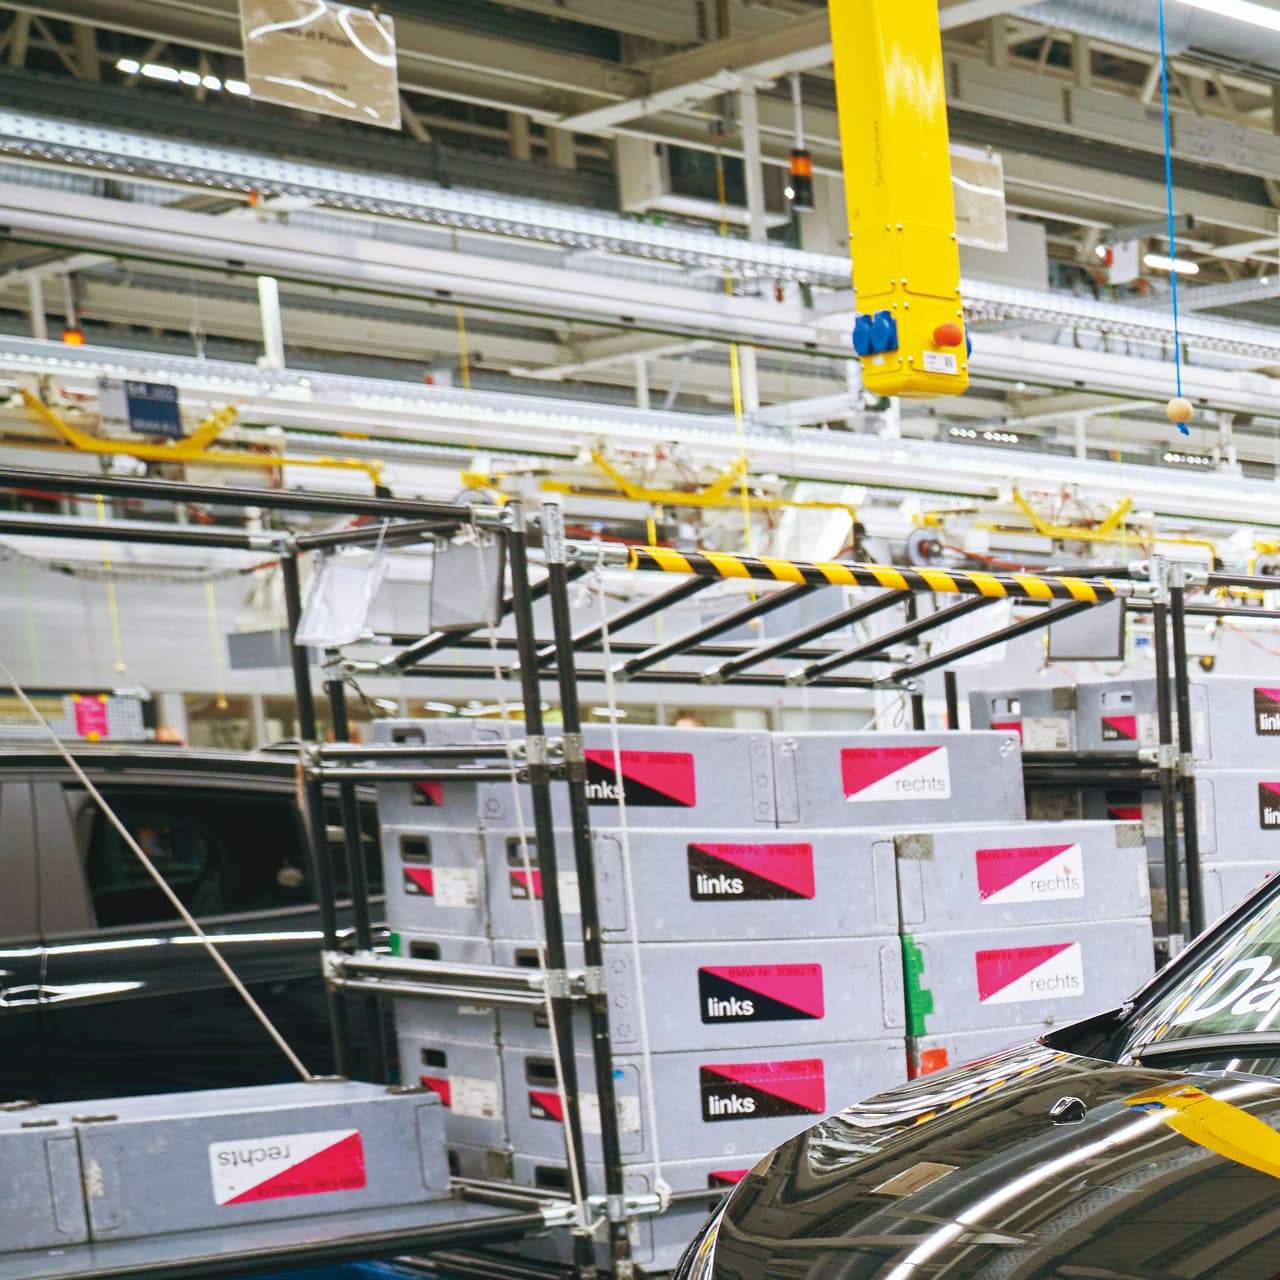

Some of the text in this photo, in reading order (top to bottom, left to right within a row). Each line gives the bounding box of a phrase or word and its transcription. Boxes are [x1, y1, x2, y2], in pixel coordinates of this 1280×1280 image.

[584, 780, 626, 800] inks
[896, 775, 945, 793] rechts
[696, 874, 744, 895] links
[1031, 874, 1080, 894] rechts
[1031, 973, 1080, 993] rechts
[707, 997, 754, 1017] links
[708, 1095, 755, 1115] links
[217, 1143, 292, 1168] rechts
